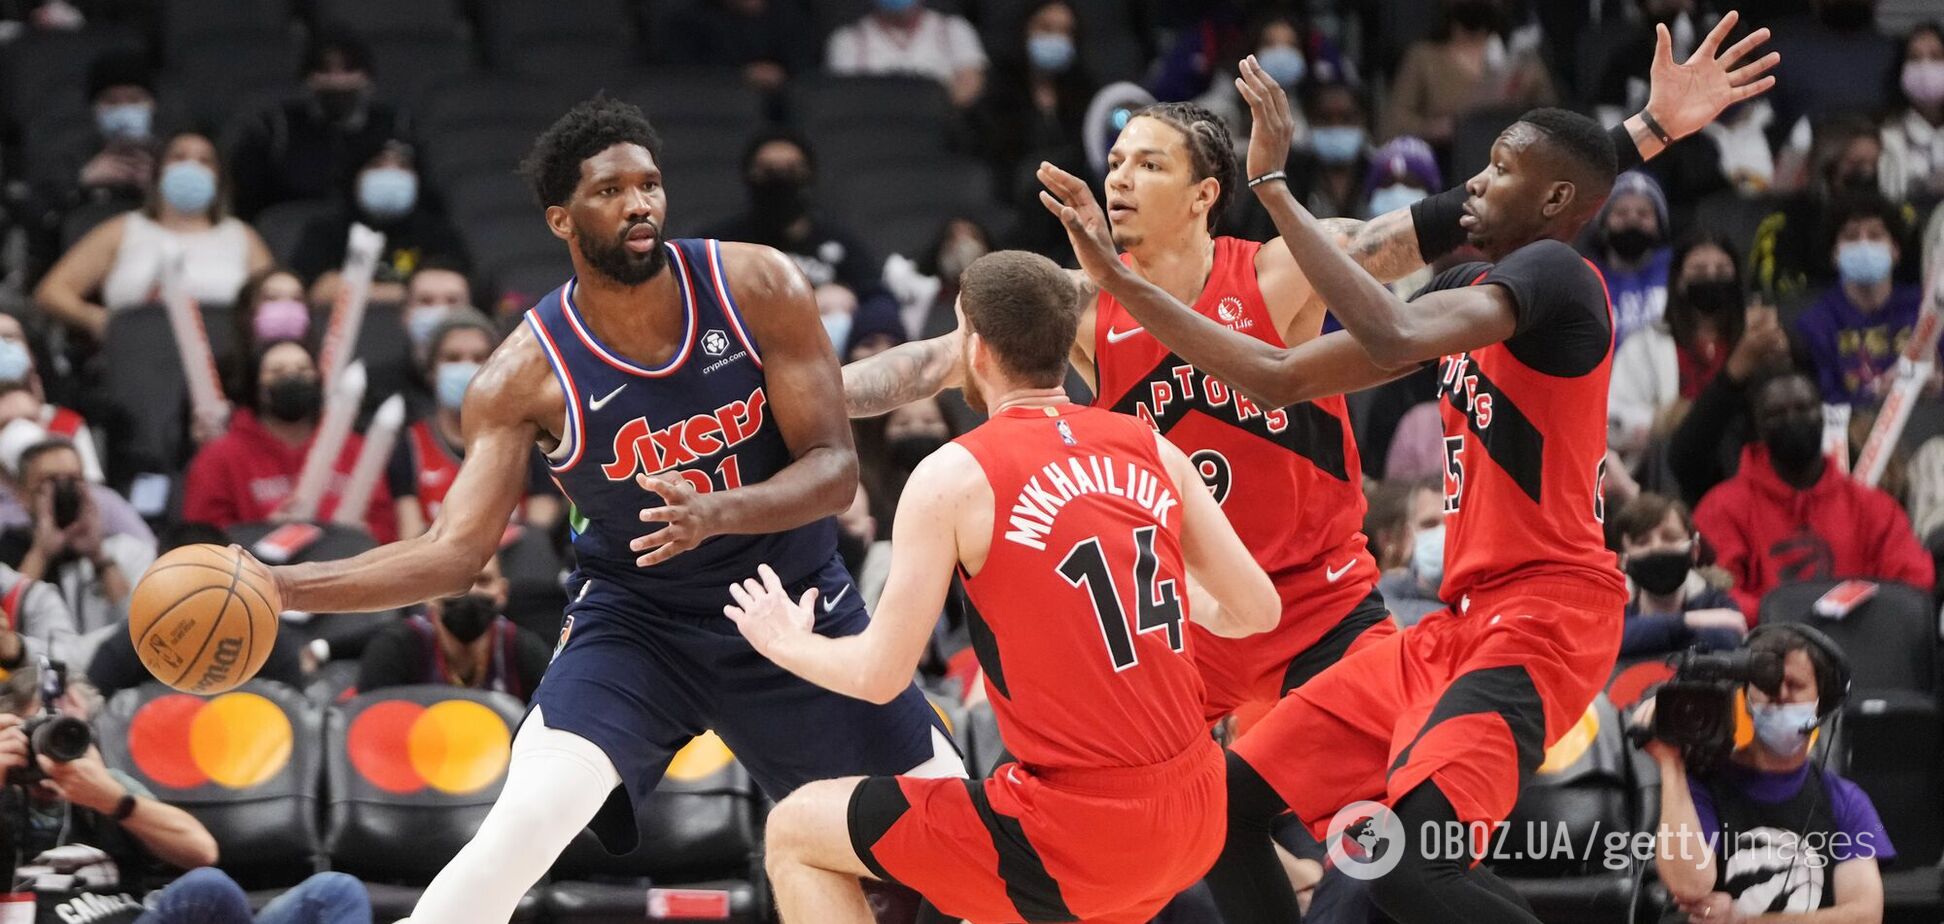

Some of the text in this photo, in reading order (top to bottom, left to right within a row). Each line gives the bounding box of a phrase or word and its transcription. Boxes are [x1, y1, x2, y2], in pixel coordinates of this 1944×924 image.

[702, 350, 747, 375] crypto.com
[1136, 364, 1289, 433] APTORS
[600, 387, 767, 481] Sixers
[1442, 434, 1464, 514] 5
[1004, 455, 1178, 551] MYKHAILIUK
[1055, 524, 1185, 673] 14
